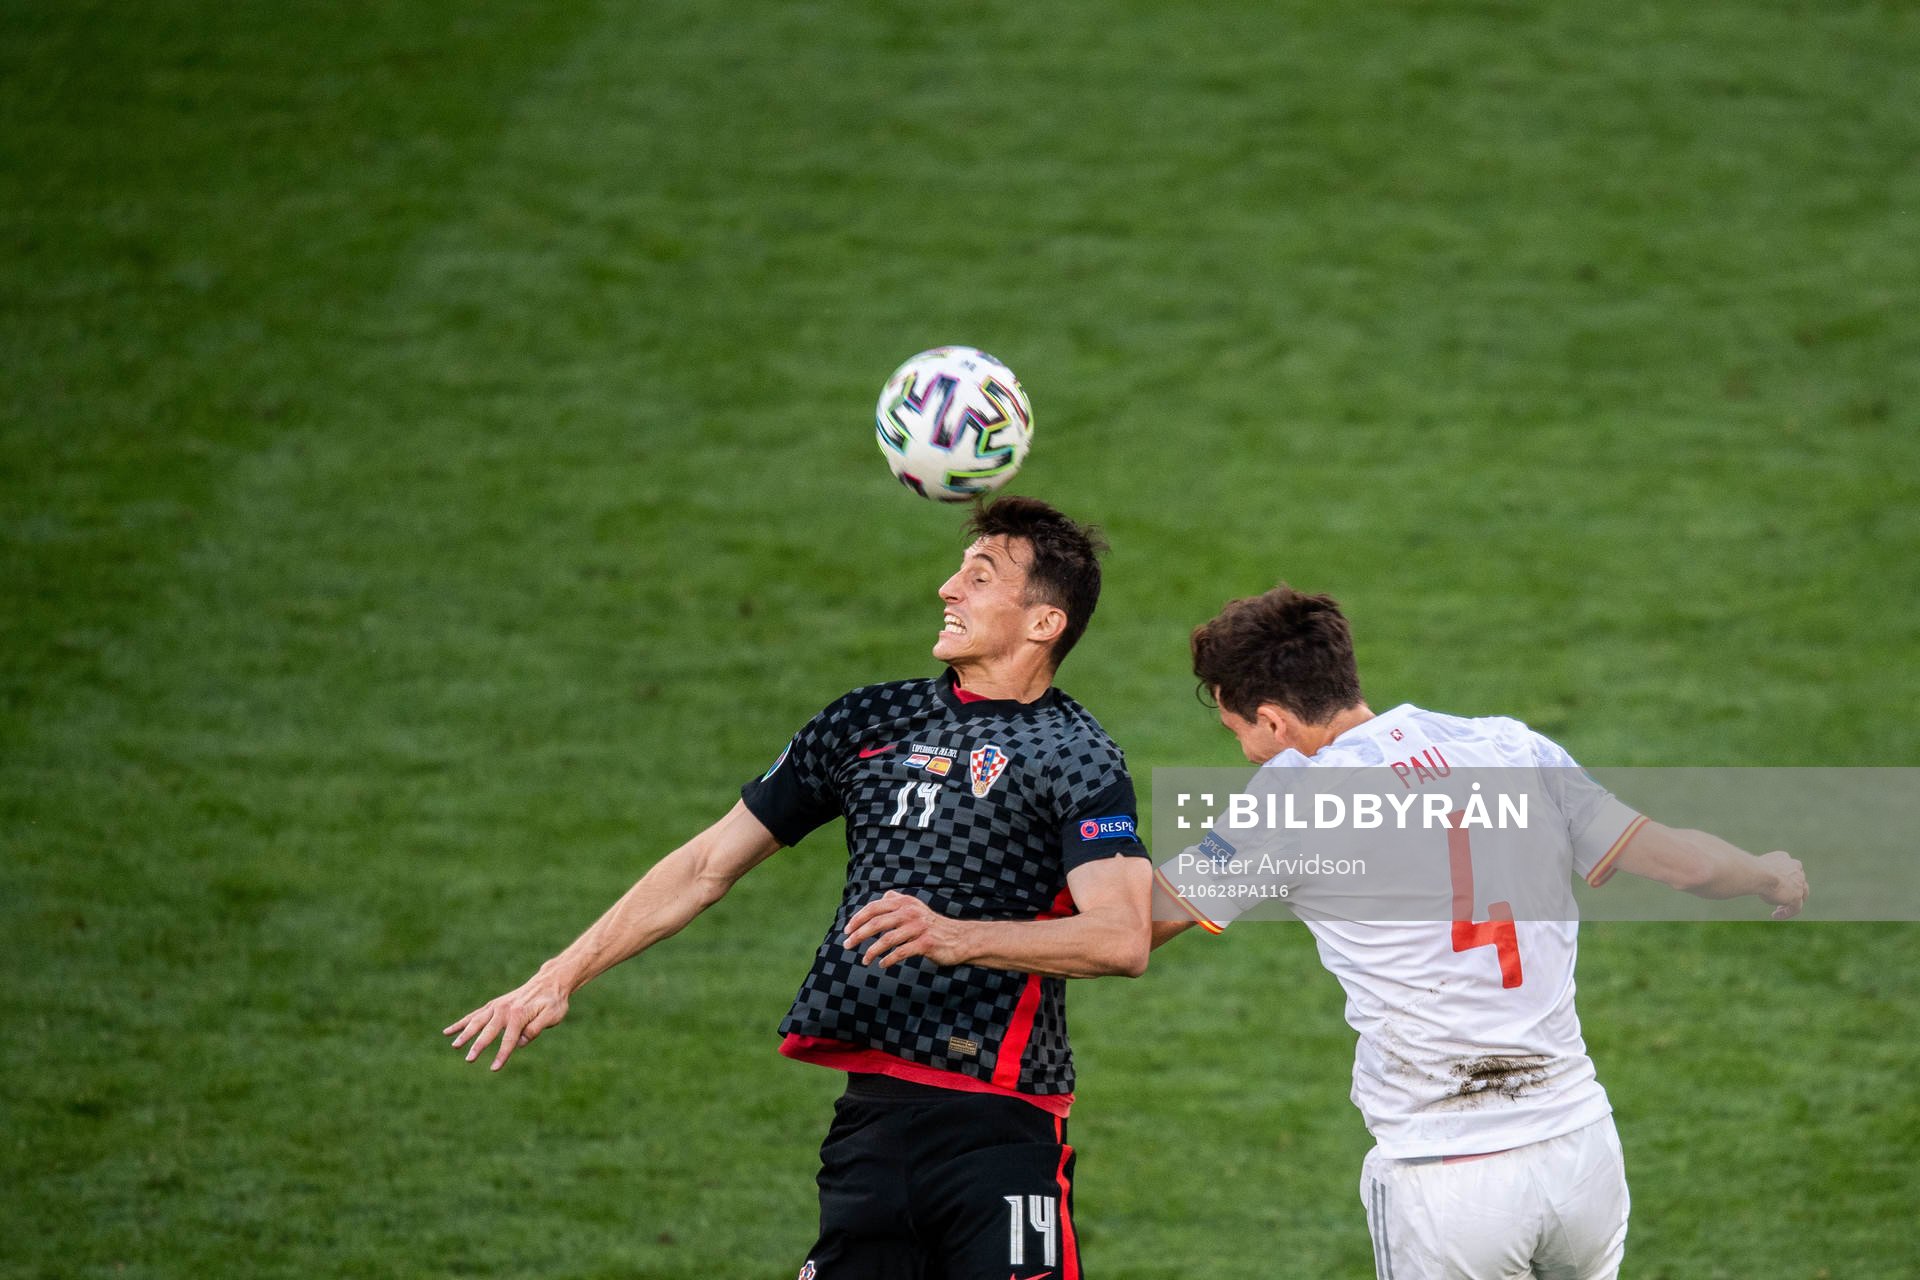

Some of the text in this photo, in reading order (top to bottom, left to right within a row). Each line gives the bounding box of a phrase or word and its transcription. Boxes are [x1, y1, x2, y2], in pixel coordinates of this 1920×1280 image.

[1390, 746, 1451, 789] PAU
[889, 781, 943, 828] 14
[1446, 808, 1523, 989] 4
[1003, 1194, 1057, 1268] 14
